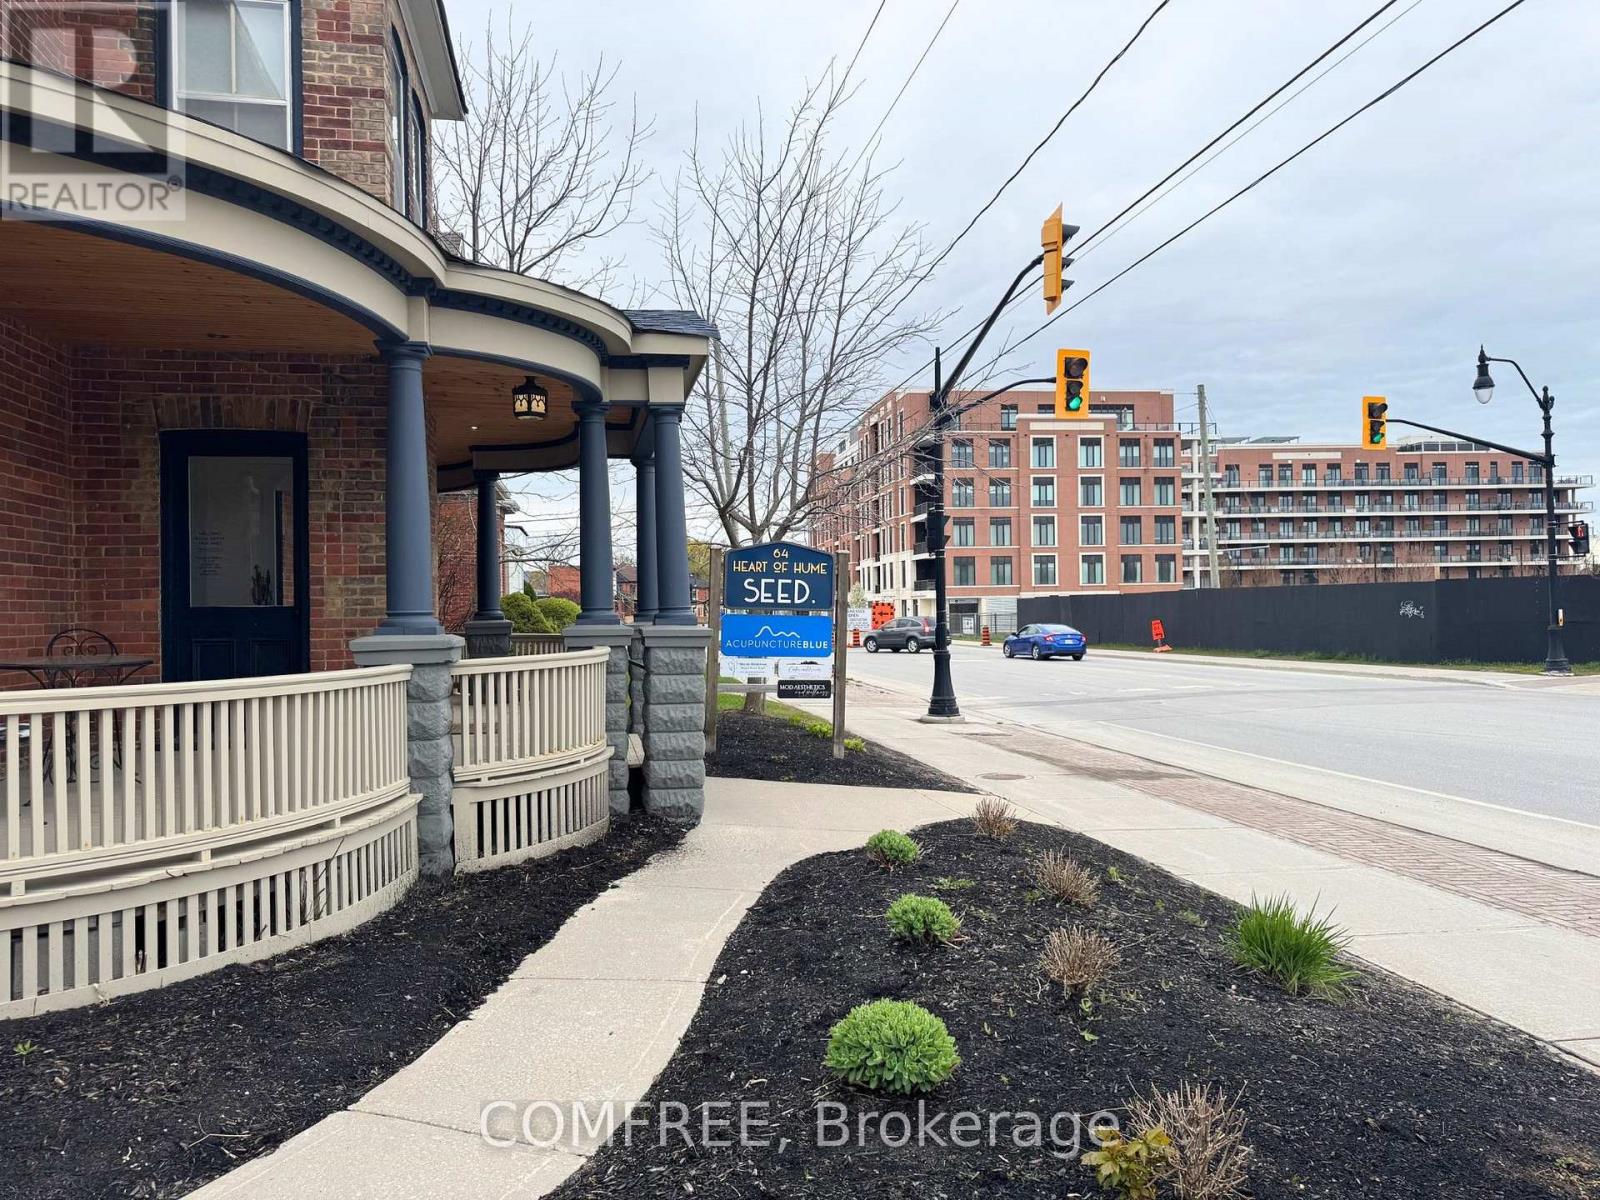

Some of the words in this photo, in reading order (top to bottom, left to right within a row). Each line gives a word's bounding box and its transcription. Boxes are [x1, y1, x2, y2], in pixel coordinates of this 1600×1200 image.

[773, 548, 789, 559] 64
[733, 560, 768, 573] HEART
[773, 561, 789, 573] OF
[793, 562, 828, 575] HUME
[743, 578, 816, 604] SEED.
